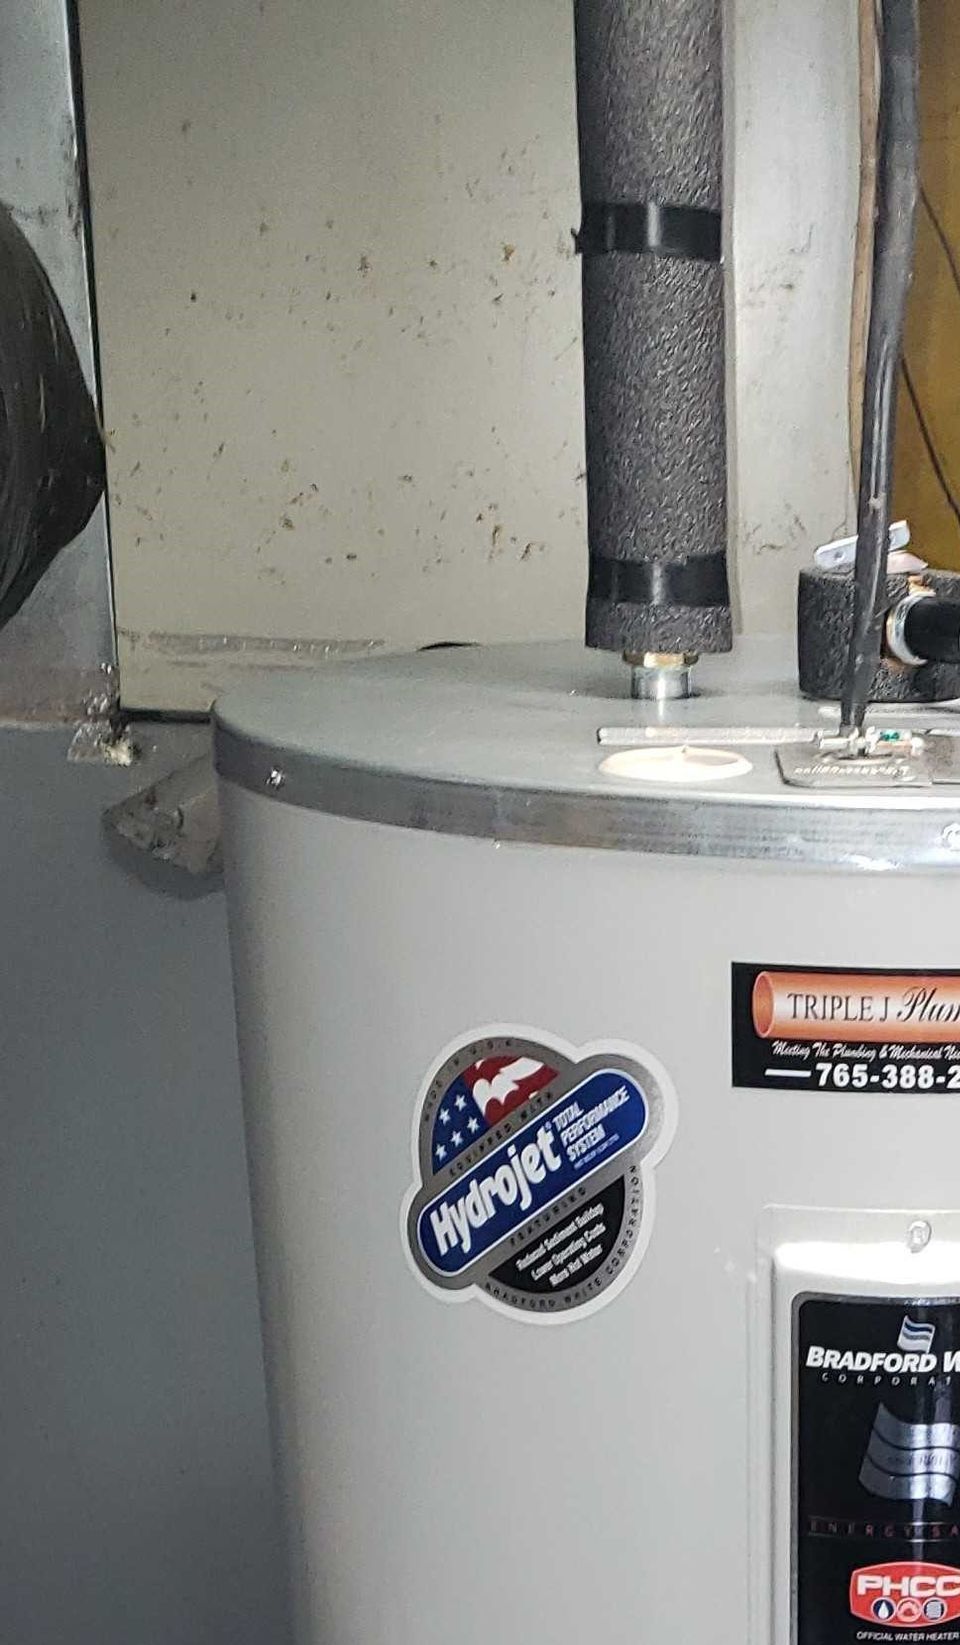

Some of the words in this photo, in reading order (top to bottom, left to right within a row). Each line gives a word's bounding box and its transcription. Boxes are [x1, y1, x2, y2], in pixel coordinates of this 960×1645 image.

[787, 992, 875, 1022] TRIPLE
[878, 996, 890, 1023] J
[772, 1040, 811, 1058] Meeting
[812, 1042, 829, 1057] The
[832, 1044, 876, 1062] Plumbing
[879, 1045, 888, 1059] &
[889, 1045, 942, 1060] Mechanical
[552, 1101, 584, 1131] TOTAL
[561, 1085, 631, 1145] PERFORMANCE
[567, 1124, 607, 1162] SYSTEM
[510, 1186, 587, 1247] FEATURING
[485, 1282, 555, 1308] BRADFORD
[564, 1277, 602, 1303] WHITE
[606, 1164, 641, 1275] CORPORATION
[806, 1345, 937, 1373] BRADFORD
[856, 1630, 894, 1641] OFFICIAL
[895, 1631, 925, 1642] WATER
[926, 1631, 960, 1641] HEATER
